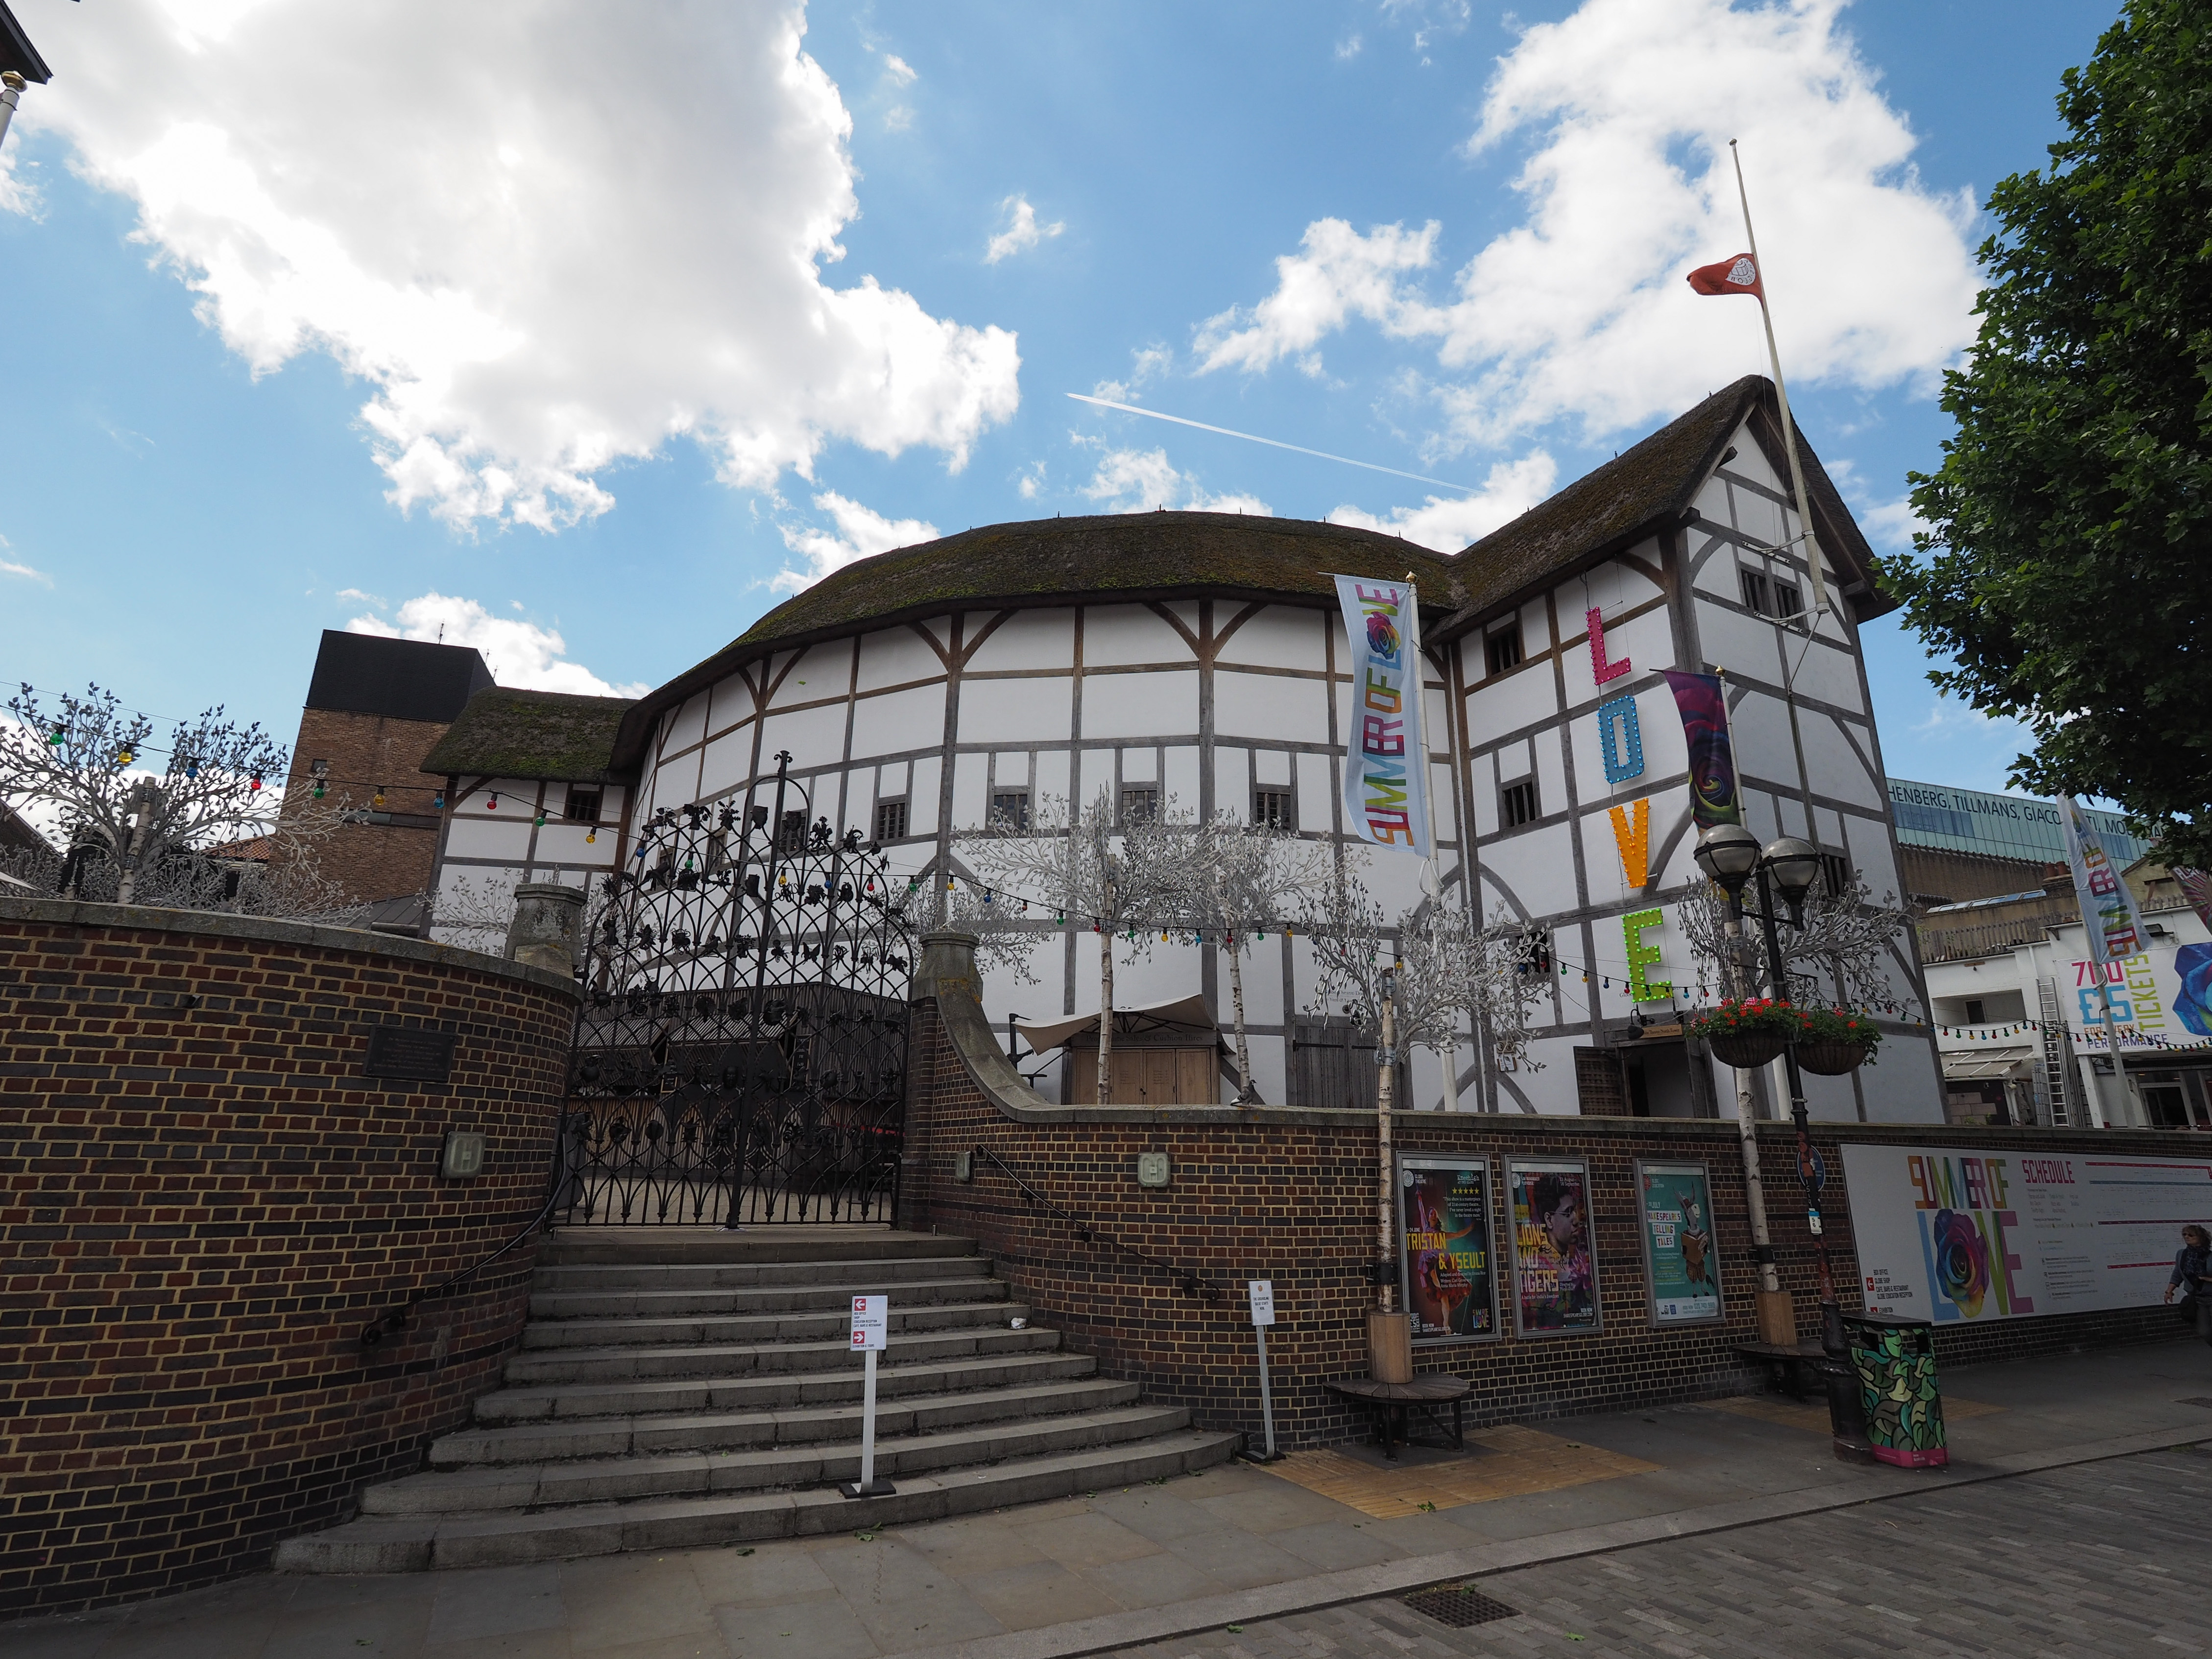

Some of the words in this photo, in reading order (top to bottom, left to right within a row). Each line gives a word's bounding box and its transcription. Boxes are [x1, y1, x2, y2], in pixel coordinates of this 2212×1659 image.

[1365, 667, 1402, 714] OF
[1362, 715, 1415, 847] SUMMER
[1585, 606, 1674, 1003] LOVE
[1952, 795, 2020, 821] TILLMANS,
[2088, 867, 2143, 957] SUMMER
[2078, 985, 2133, 1025] £5
[2123, 954, 2165, 1032] TICKETS
[2084, 1027, 2101, 1035] FOR
[2088, 1034, 2168, 1049] PERORMANCE
[1907, 1155, 1991, 1209] SUMMER
[1985, 1158, 2009, 1209] OF
[2021, 1160, 2075, 1183] SCHEDULE
[1406, 1233, 1446, 1250] TRISTAN
[1516, 1224, 1548, 1245] LIONS
[1654, 1225, 1674, 1234] TELLING
[1658, 1237, 1673, 1247] TALES
[1439, 1253, 1447, 1270] &
[1450, 1251, 1485, 1269] YSEULT
[1917, 1211, 2034, 1321] LOVE
[1519, 1270, 1559, 1293] TIGERS
